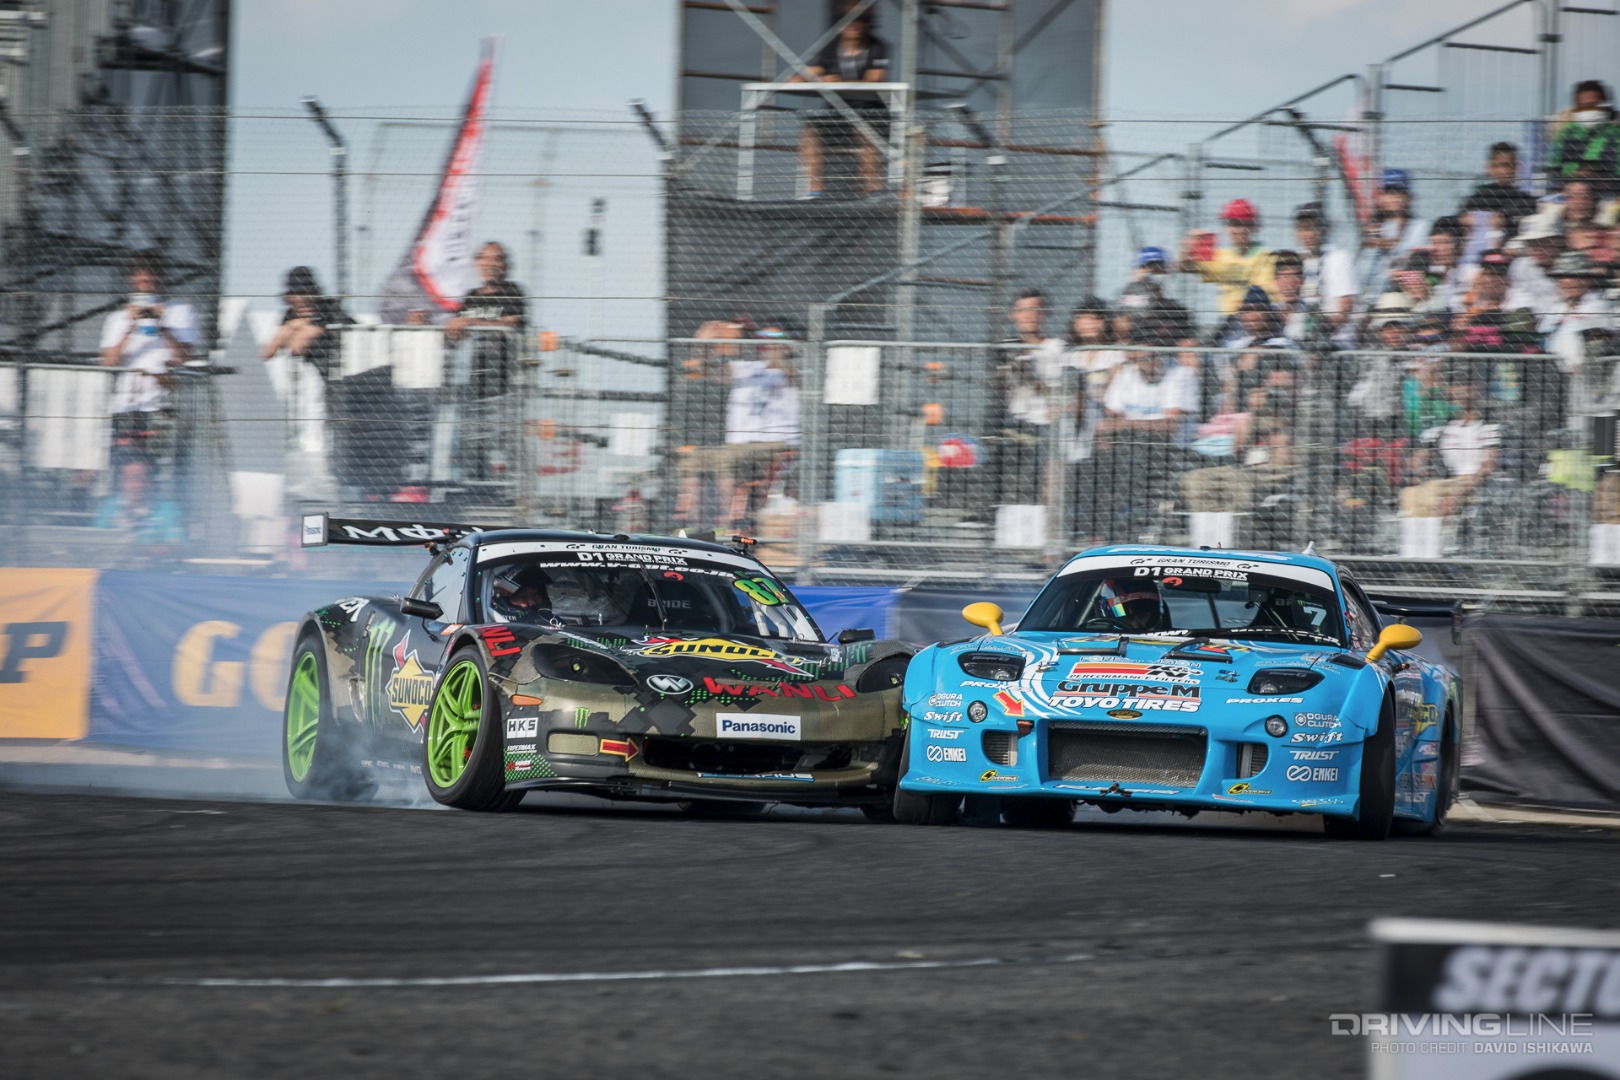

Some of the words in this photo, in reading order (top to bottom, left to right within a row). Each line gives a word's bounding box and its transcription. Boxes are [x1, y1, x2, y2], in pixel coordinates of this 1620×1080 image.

[621, 544, 661, 552] TURISMO
[577, 552, 604, 562] D1
[606, 553, 652, 562] GRAND
[653, 556, 687, 565] PRIX
[1186, 559, 1230, 567] TURISMO
[1134, 567, 1162, 577] D1
[1163, 568, 1212, 576] GRAND
[1213, 569, 1249, 579] PRIX
[734, 577, 790, 605] 87
[1303, 605, 1327, 627] 7
[1154, 677, 1199, 685] FILTERS
[391, 677, 431, 705] SUNOCO
[703, 677, 856, 701] WANLI
[1050, 697, 1122, 709] TOYO
[1120, 699, 1201, 712] TIRES
[924, 712, 963, 722] Swift
[1306, 712, 1340, 722] OGURA
[508, 720, 536, 732] HKS
[721, 719, 796, 734] Panasonic
[1307, 720, 1342, 728] CLUTCH
[927, 728, 965, 739] TRUST
[1290, 731, 1343, 743] Swift
[943, 747, 967, 762] ENKEI
[1290, 750, 1340, 760] TRUST
[1313, 767, 1339, 782] ENKEI
